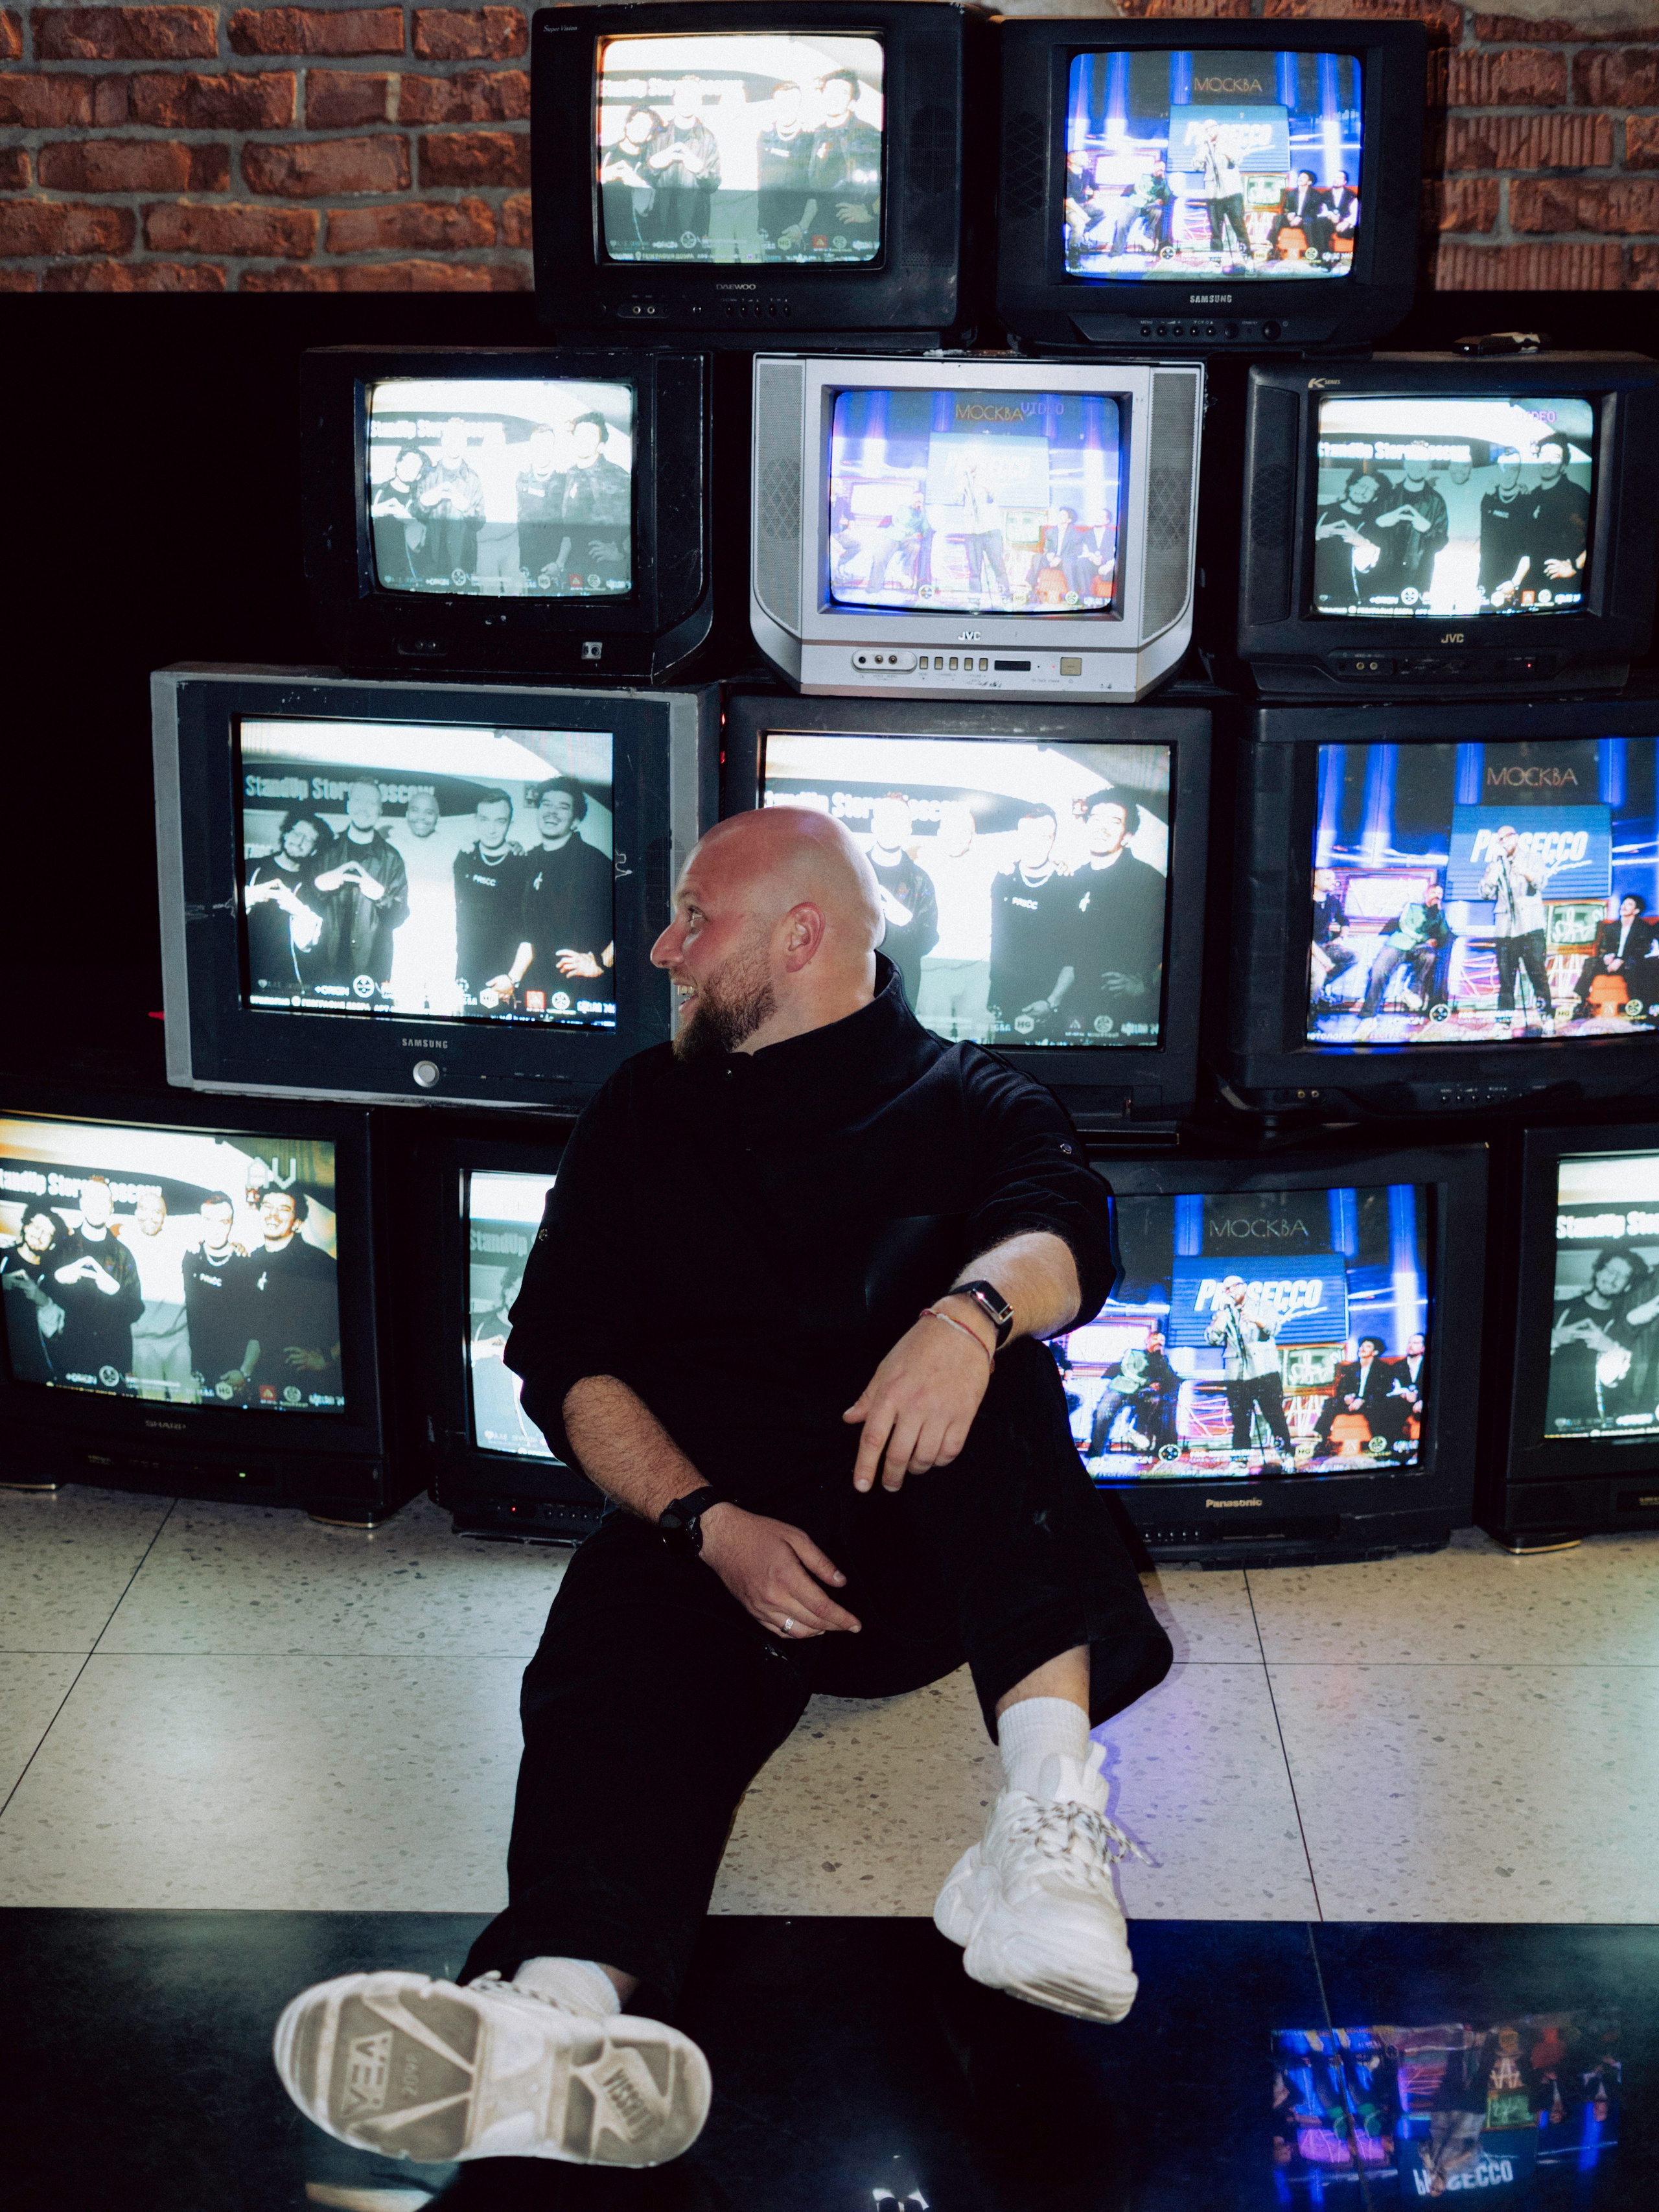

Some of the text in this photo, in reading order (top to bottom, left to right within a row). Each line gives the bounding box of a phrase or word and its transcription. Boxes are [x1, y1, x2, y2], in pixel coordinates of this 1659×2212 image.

[1190, 295, 1233, 303] SAMSUNG
[958, 631, 981, 641] JVC
[1441, 633, 1465, 644] JVC
[1017, 1020, 1032, 1029] HG
[402, 1038, 448, 1049] SAMSUNG
[1205, 1496, 1263, 1508] Panasonic
